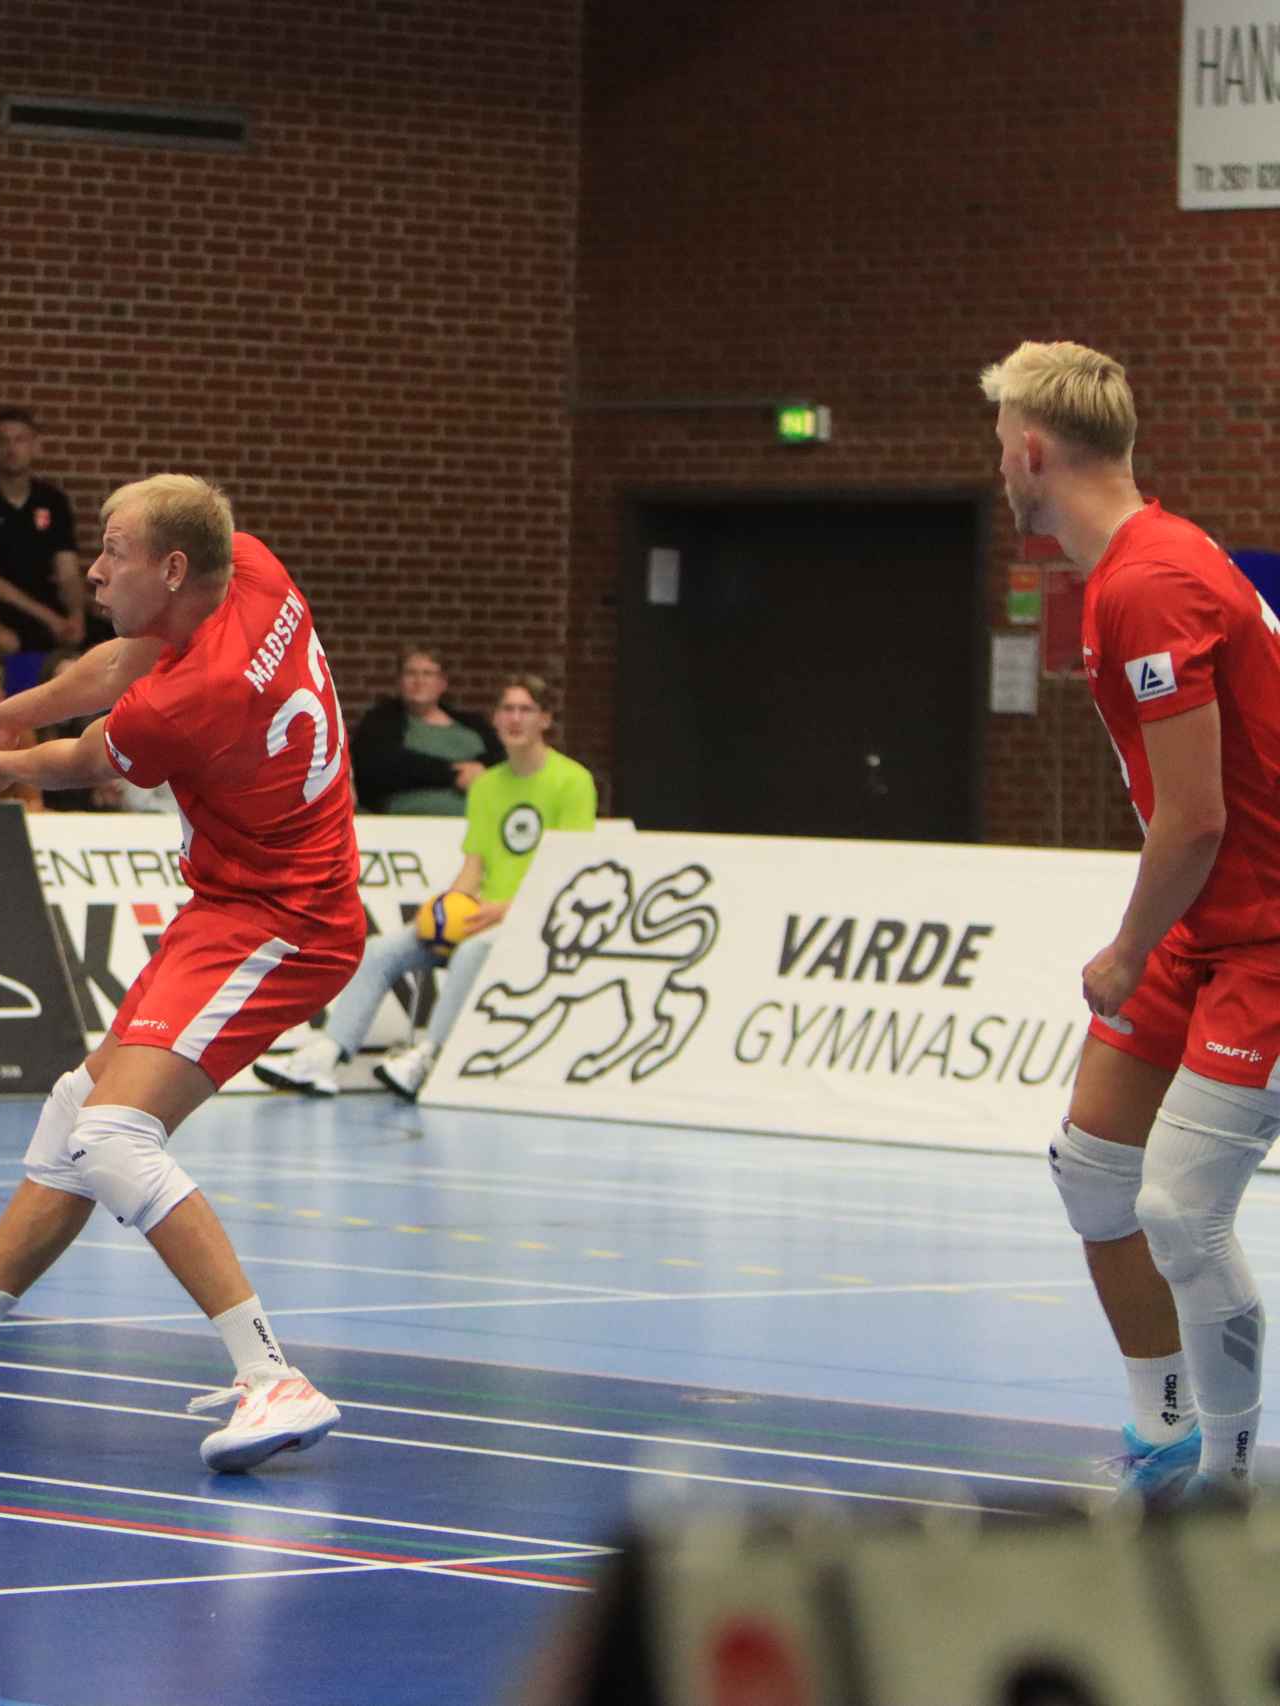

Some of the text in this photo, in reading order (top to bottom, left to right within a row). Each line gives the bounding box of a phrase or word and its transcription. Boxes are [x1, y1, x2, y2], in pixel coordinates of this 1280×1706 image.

[1195, 23, 1280, 108] HAN
[243, 589, 306, 695] MADSEN
[778, 913, 996, 988] VARDE
[1205, 1041, 1251, 1063] CRAFT
[1165, 1374, 1178, 1409] CRAFT
